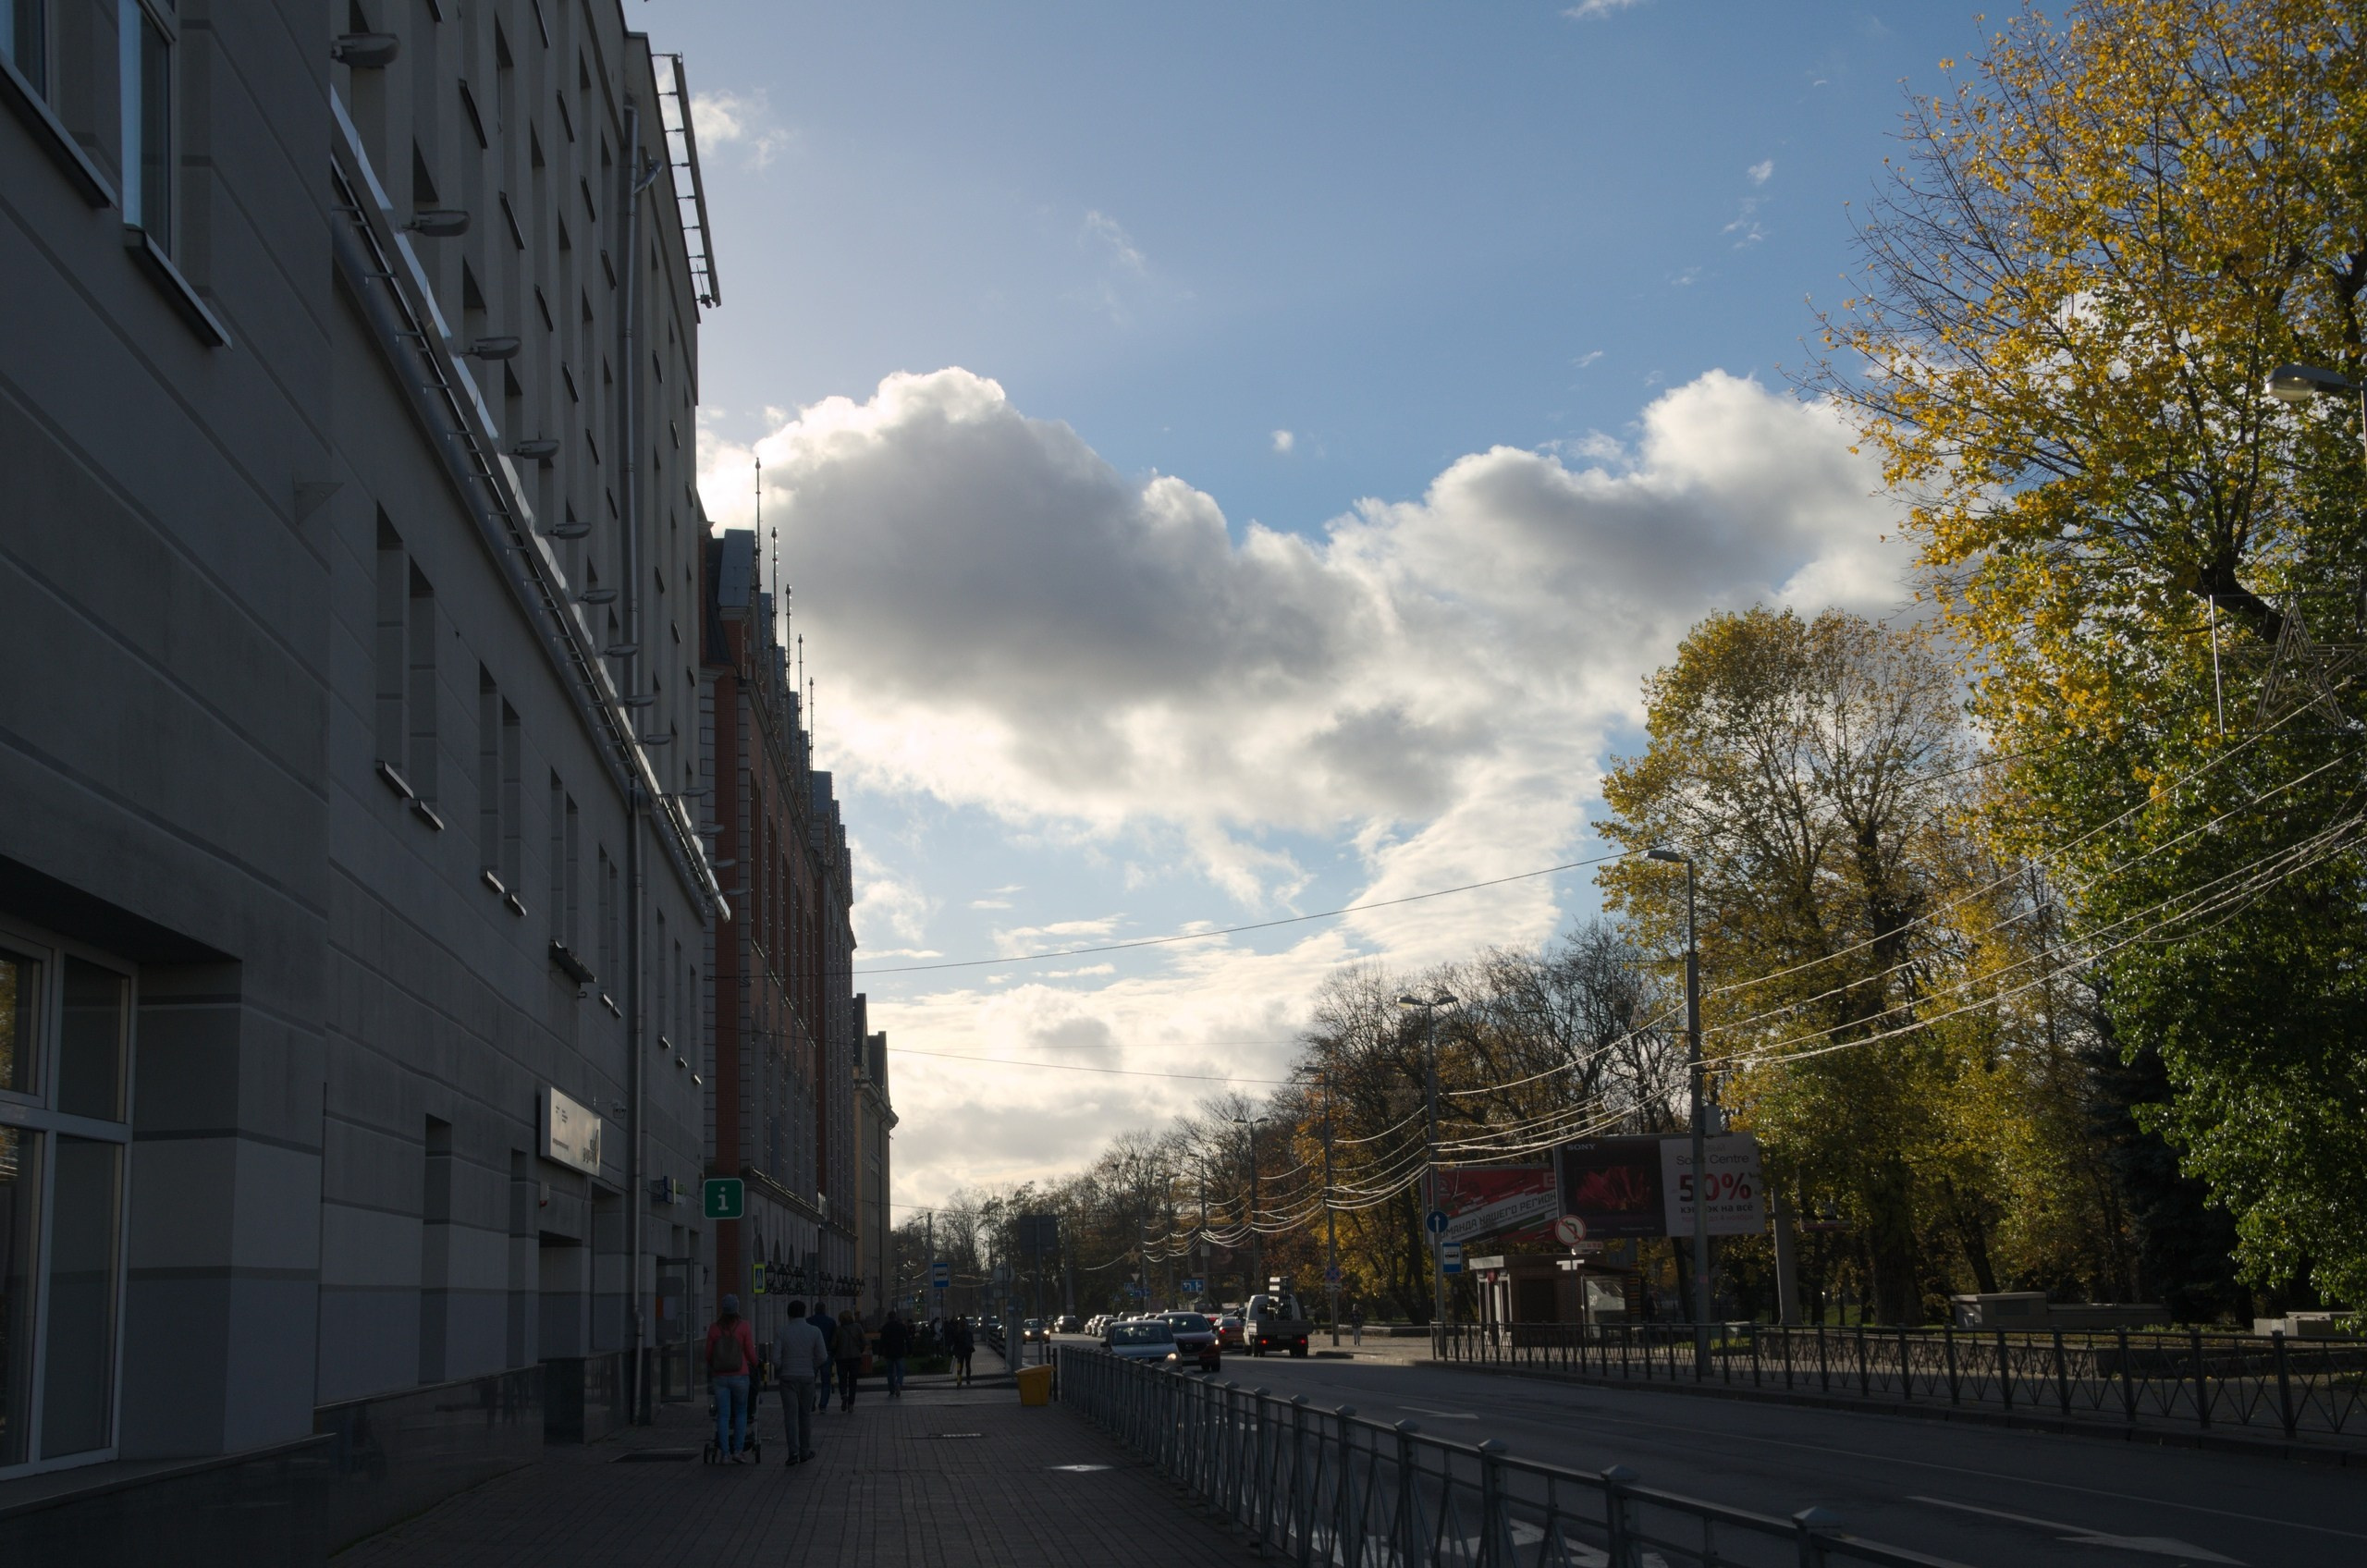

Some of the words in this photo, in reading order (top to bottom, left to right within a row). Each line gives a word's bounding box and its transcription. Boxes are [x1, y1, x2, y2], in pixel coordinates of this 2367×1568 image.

[1710, 1154, 1749, 1165] Centre
[1679, 1172, 1752, 1202] 50%
[1736, 1202, 1754, 1212] всё
[1441, 1219, 1478, 1238] МАНДА
[1479, 1205, 1517, 1226] НАШЕГО
